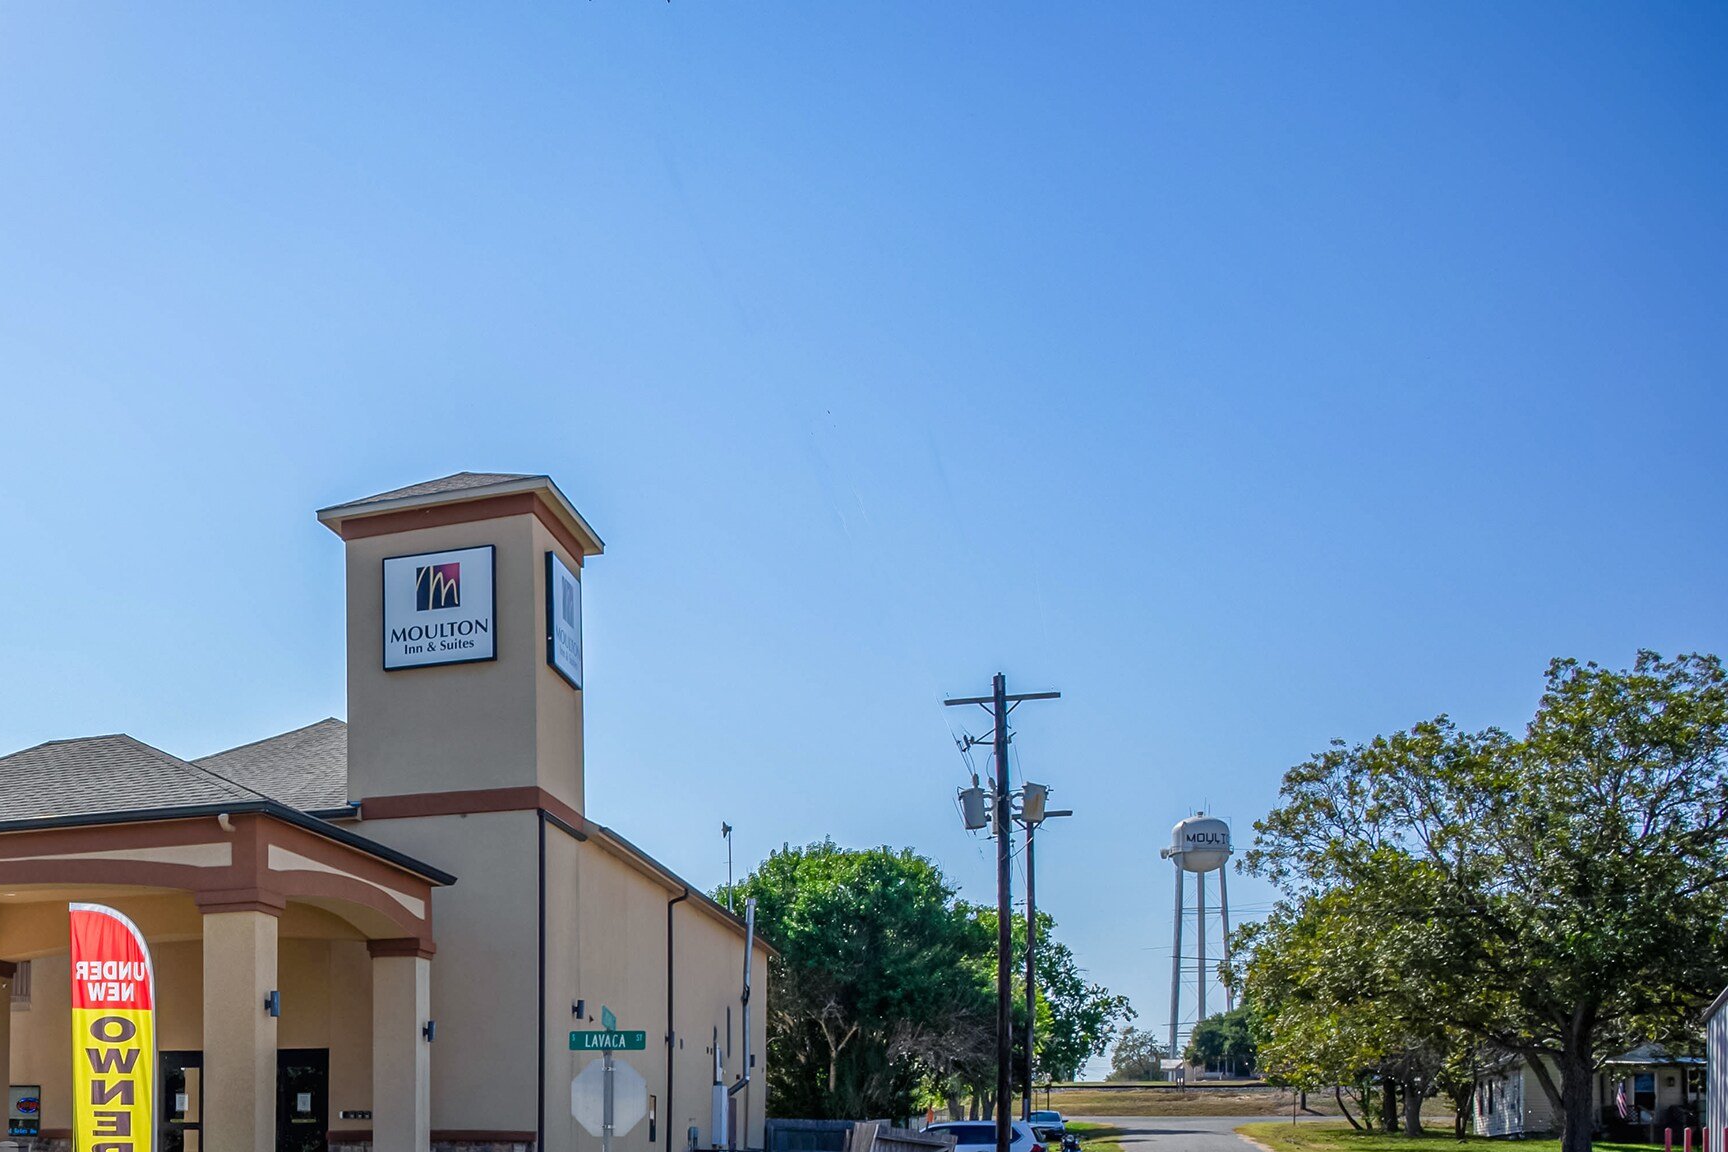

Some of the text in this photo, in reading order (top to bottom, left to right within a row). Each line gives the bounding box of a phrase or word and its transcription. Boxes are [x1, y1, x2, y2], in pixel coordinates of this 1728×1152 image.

[390, 618, 488, 643] MOULTON
[404, 638, 475, 655] Inn & Suites
[572, 1034, 576, 1042] S
[584, 1034, 626, 1048] LAVACA
